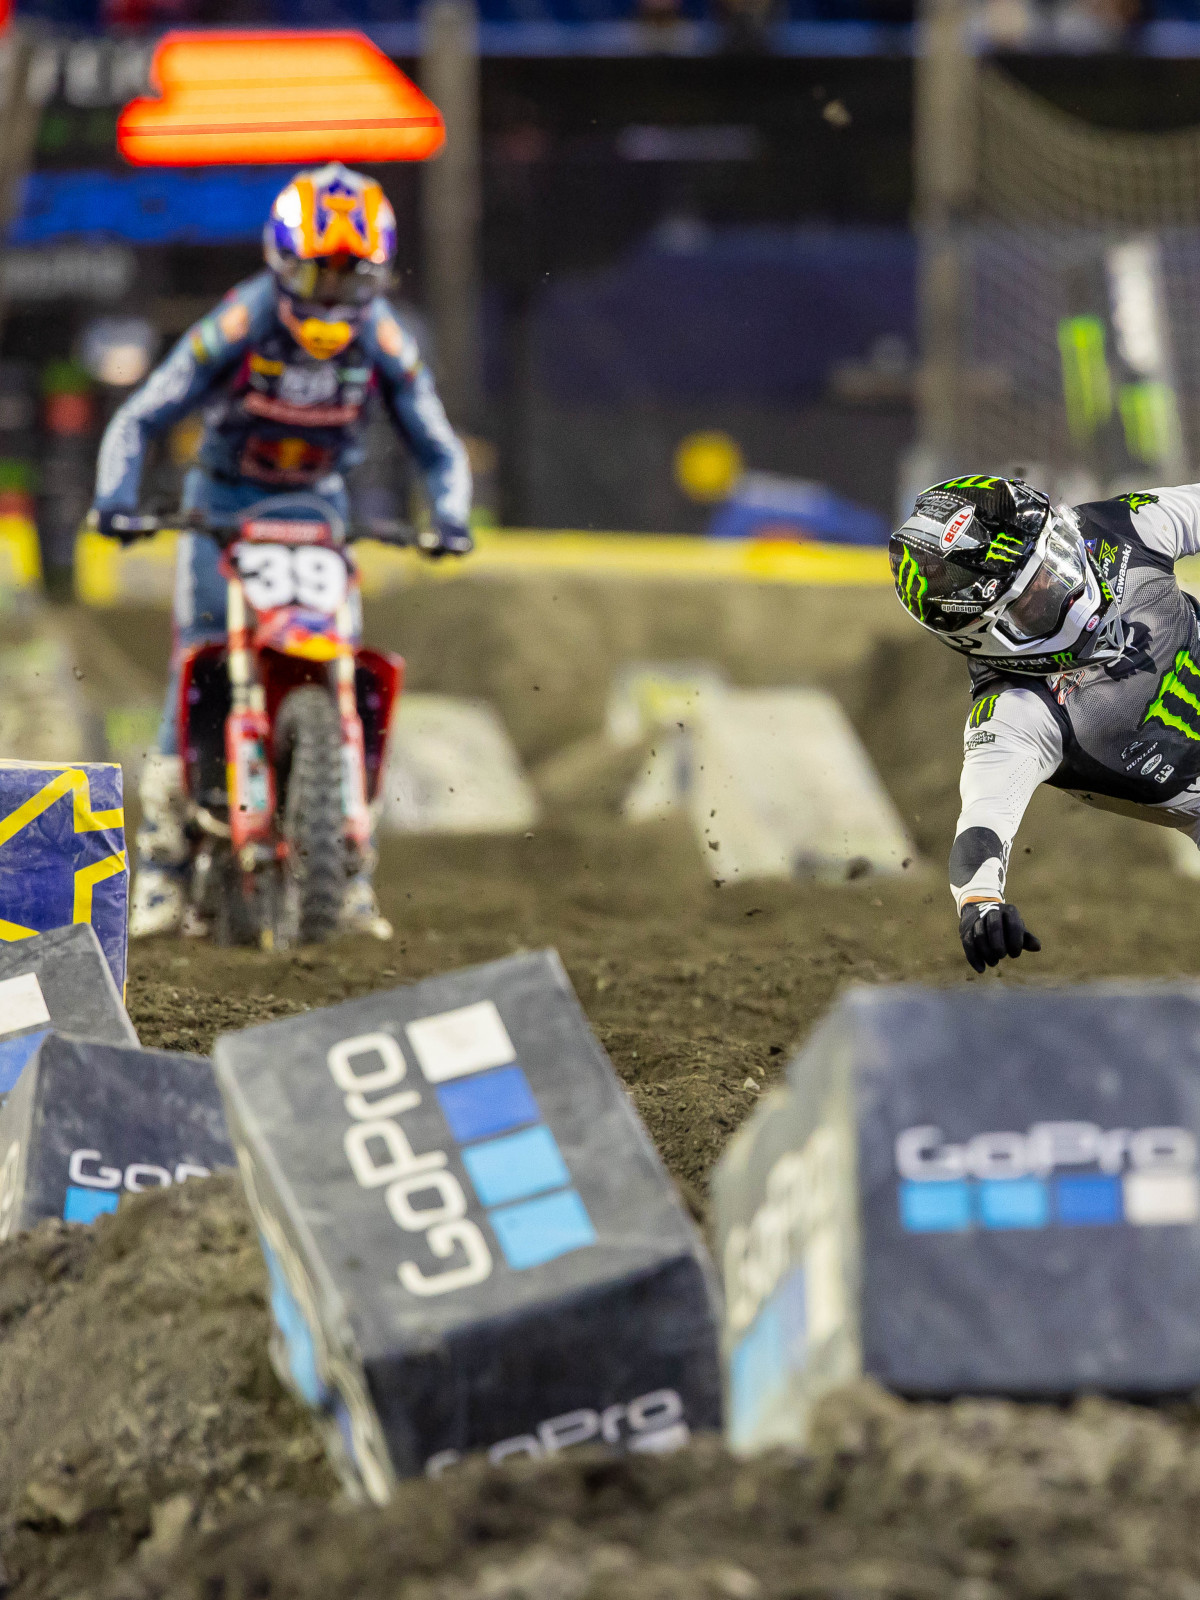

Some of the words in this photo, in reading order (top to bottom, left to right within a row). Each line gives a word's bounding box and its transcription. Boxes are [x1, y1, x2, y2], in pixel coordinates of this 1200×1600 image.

[944, 513, 970, 544] BELL
[235, 543, 349, 613] 39
[941, 604, 982, 613] apdesigns
[1126, 742, 1158, 771] DUNLOP
[328, 1031, 493, 1296] GoPro
[896, 1121, 1198, 1182] GoPro
